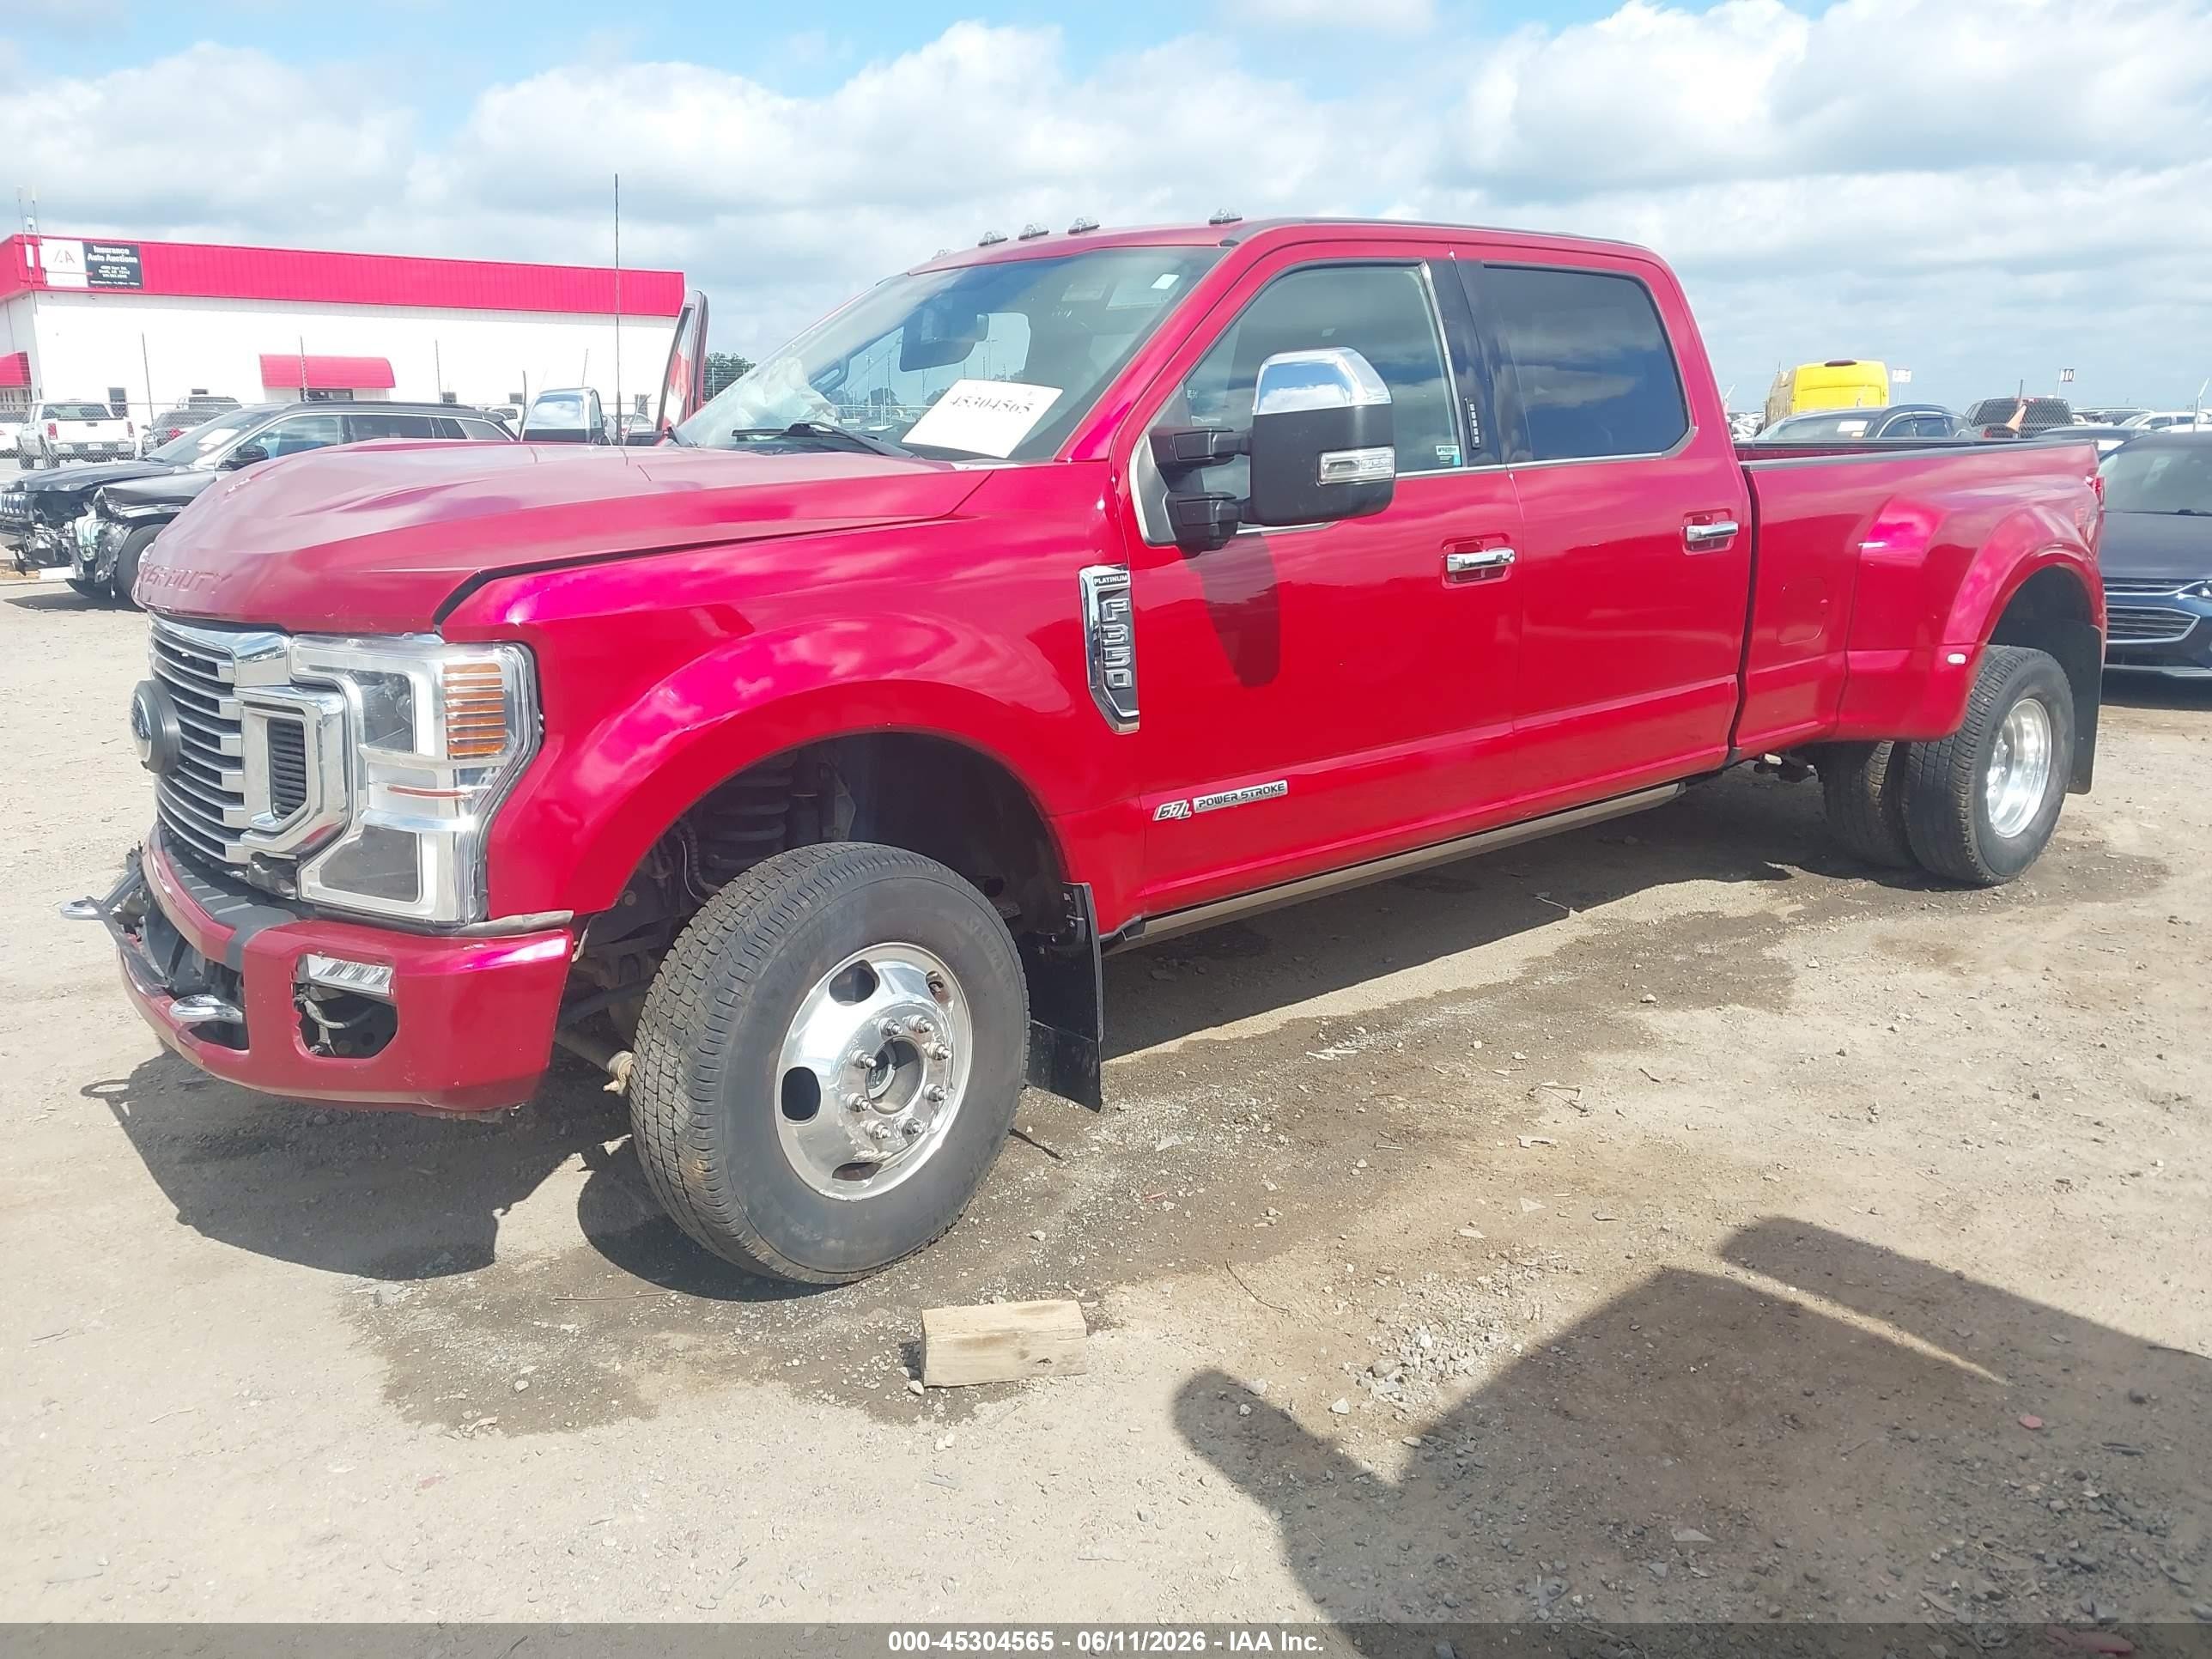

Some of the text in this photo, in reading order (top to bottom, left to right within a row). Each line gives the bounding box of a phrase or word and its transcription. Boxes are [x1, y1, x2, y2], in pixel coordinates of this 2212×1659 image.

[93, 246, 130, 255] Insurance
[87, 252, 138, 264] Auto Auctions
[2063, 368, 2075, 382] 10
[164, 568, 233, 593] DUTY
[1094, 574, 1128, 586] PLATINUM
[1154, 799, 1192, 821] 6.7L
[1198, 793, 1238, 808] POWER
[1241, 782, 1285, 799] STROKE
